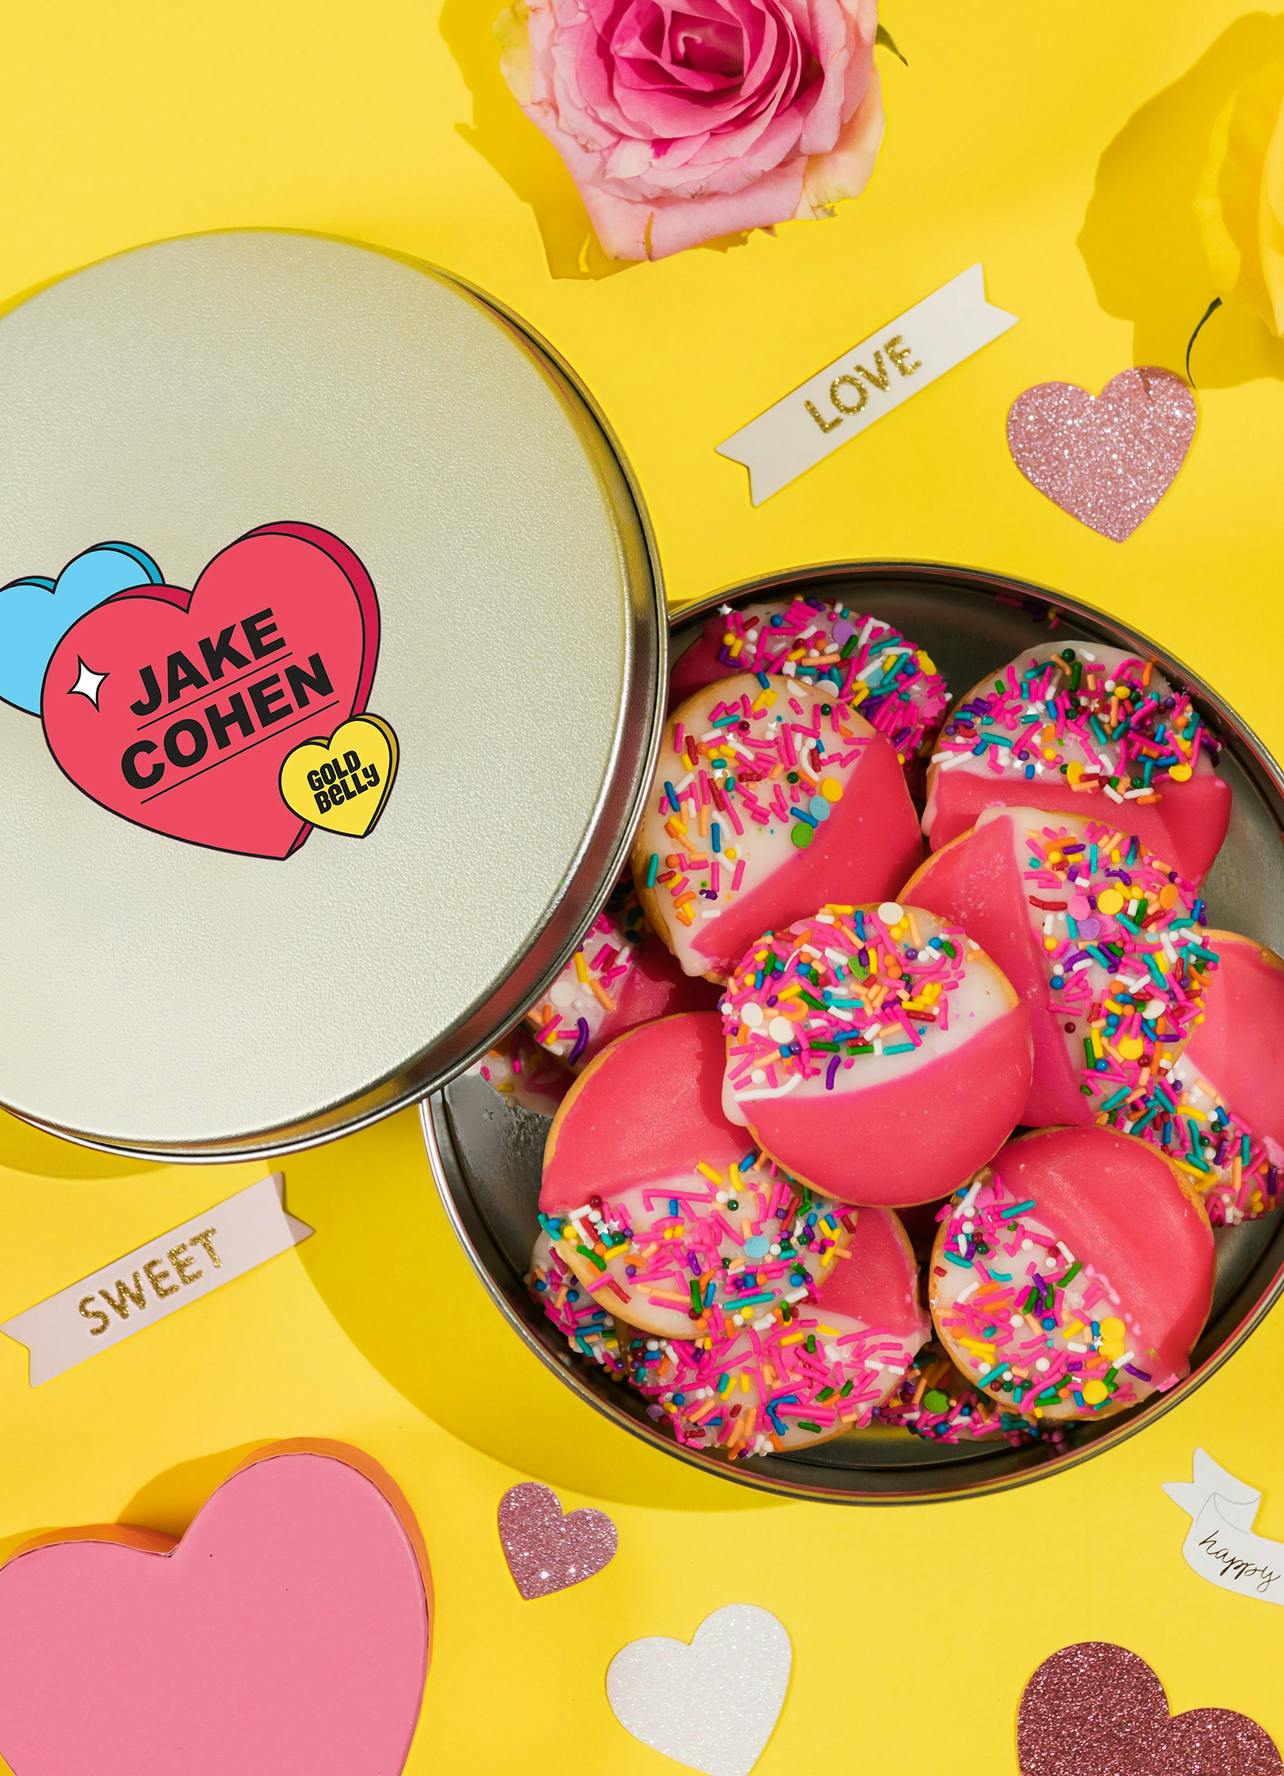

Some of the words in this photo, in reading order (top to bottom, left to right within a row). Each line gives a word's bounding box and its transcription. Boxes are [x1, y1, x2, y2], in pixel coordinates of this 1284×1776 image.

[804, 335, 922, 433] LOVE
[129, 607, 287, 716] JAKE
[121, 652, 335, 790] COHEN
[306, 750, 362, 792] GOLD
[78, 1227, 223, 1336] SWEET
[1198, 1530, 1281, 1593] happy
